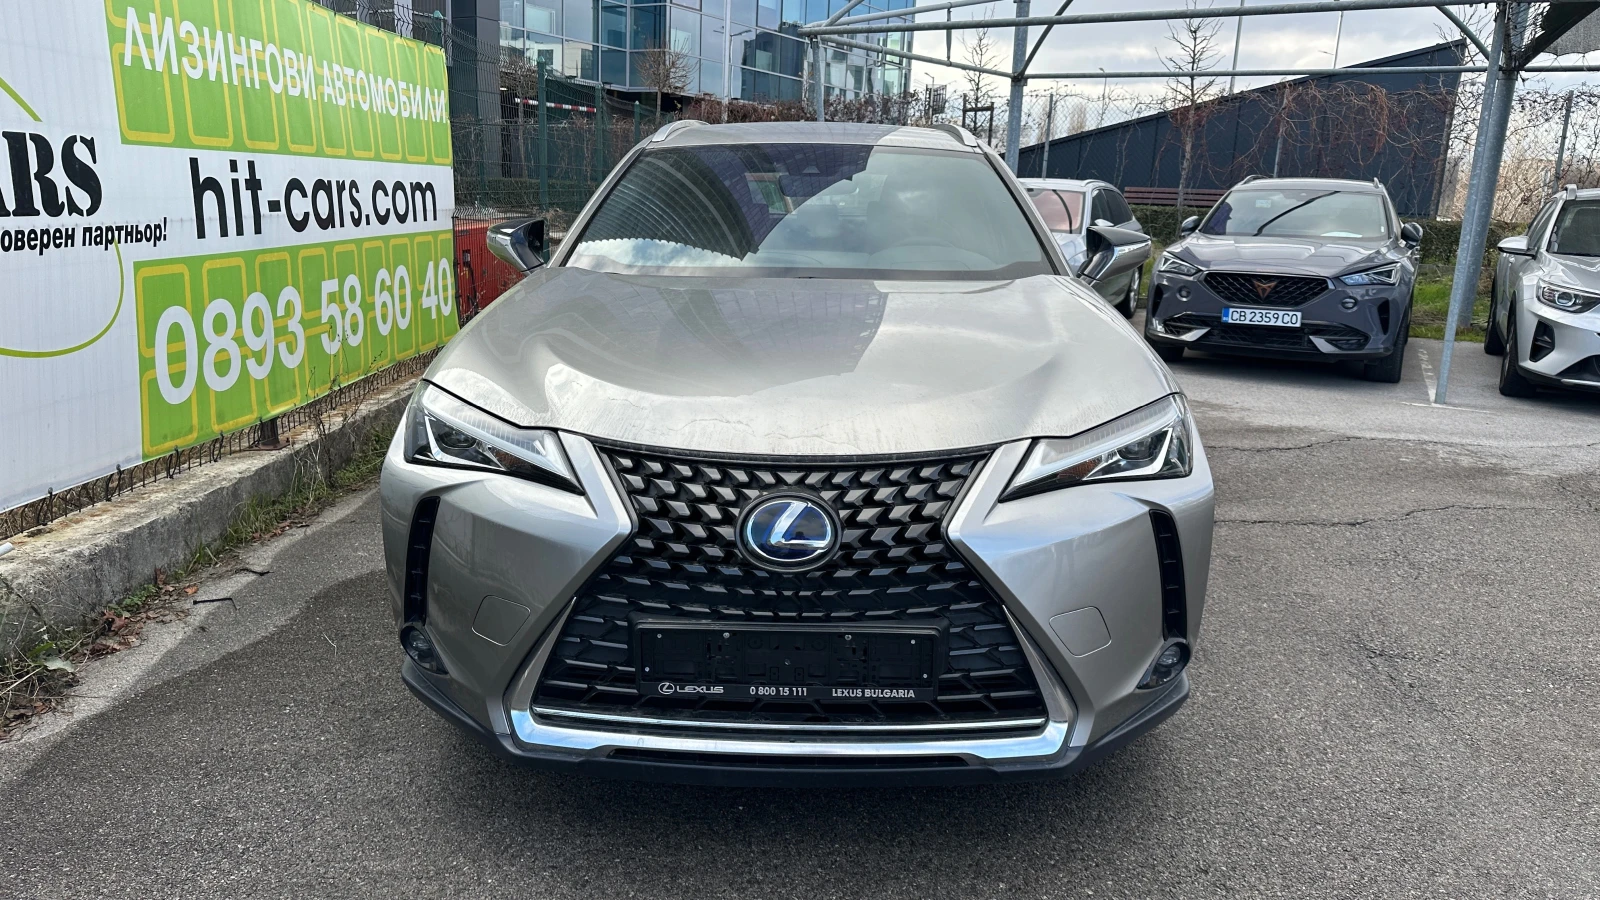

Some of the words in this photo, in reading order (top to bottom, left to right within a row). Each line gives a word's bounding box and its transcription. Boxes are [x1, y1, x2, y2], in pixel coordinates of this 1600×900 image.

[123, 6, 316, 101] ЛИЗИНГОВИ
[322, 60, 446, 123] АВТОМОБИЛИ
[0, 130, 103, 218] RS
[188, 157, 438, 239] hit-cars.com
[81, 217, 167, 248] партньор!
[154, 285, 305, 405] 0893
[320, 273, 364, 355] 58
[374, 264, 412, 336] 60
[421, 257, 452, 320] 40
[1230, 310, 1247, 322] CB
[1249, 311, 1280, 324] 2359
[676, 686, 724, 694] LEXUS
[749, 686, 756, 695] 0
[757, 686, 776, 696] 800
[778, 687, 789, 696] 15
[792, 687, 807, 696] 111
[832, 688, 863, 698] LEXUS
[864, 689, 915, 698] BULGARIA
